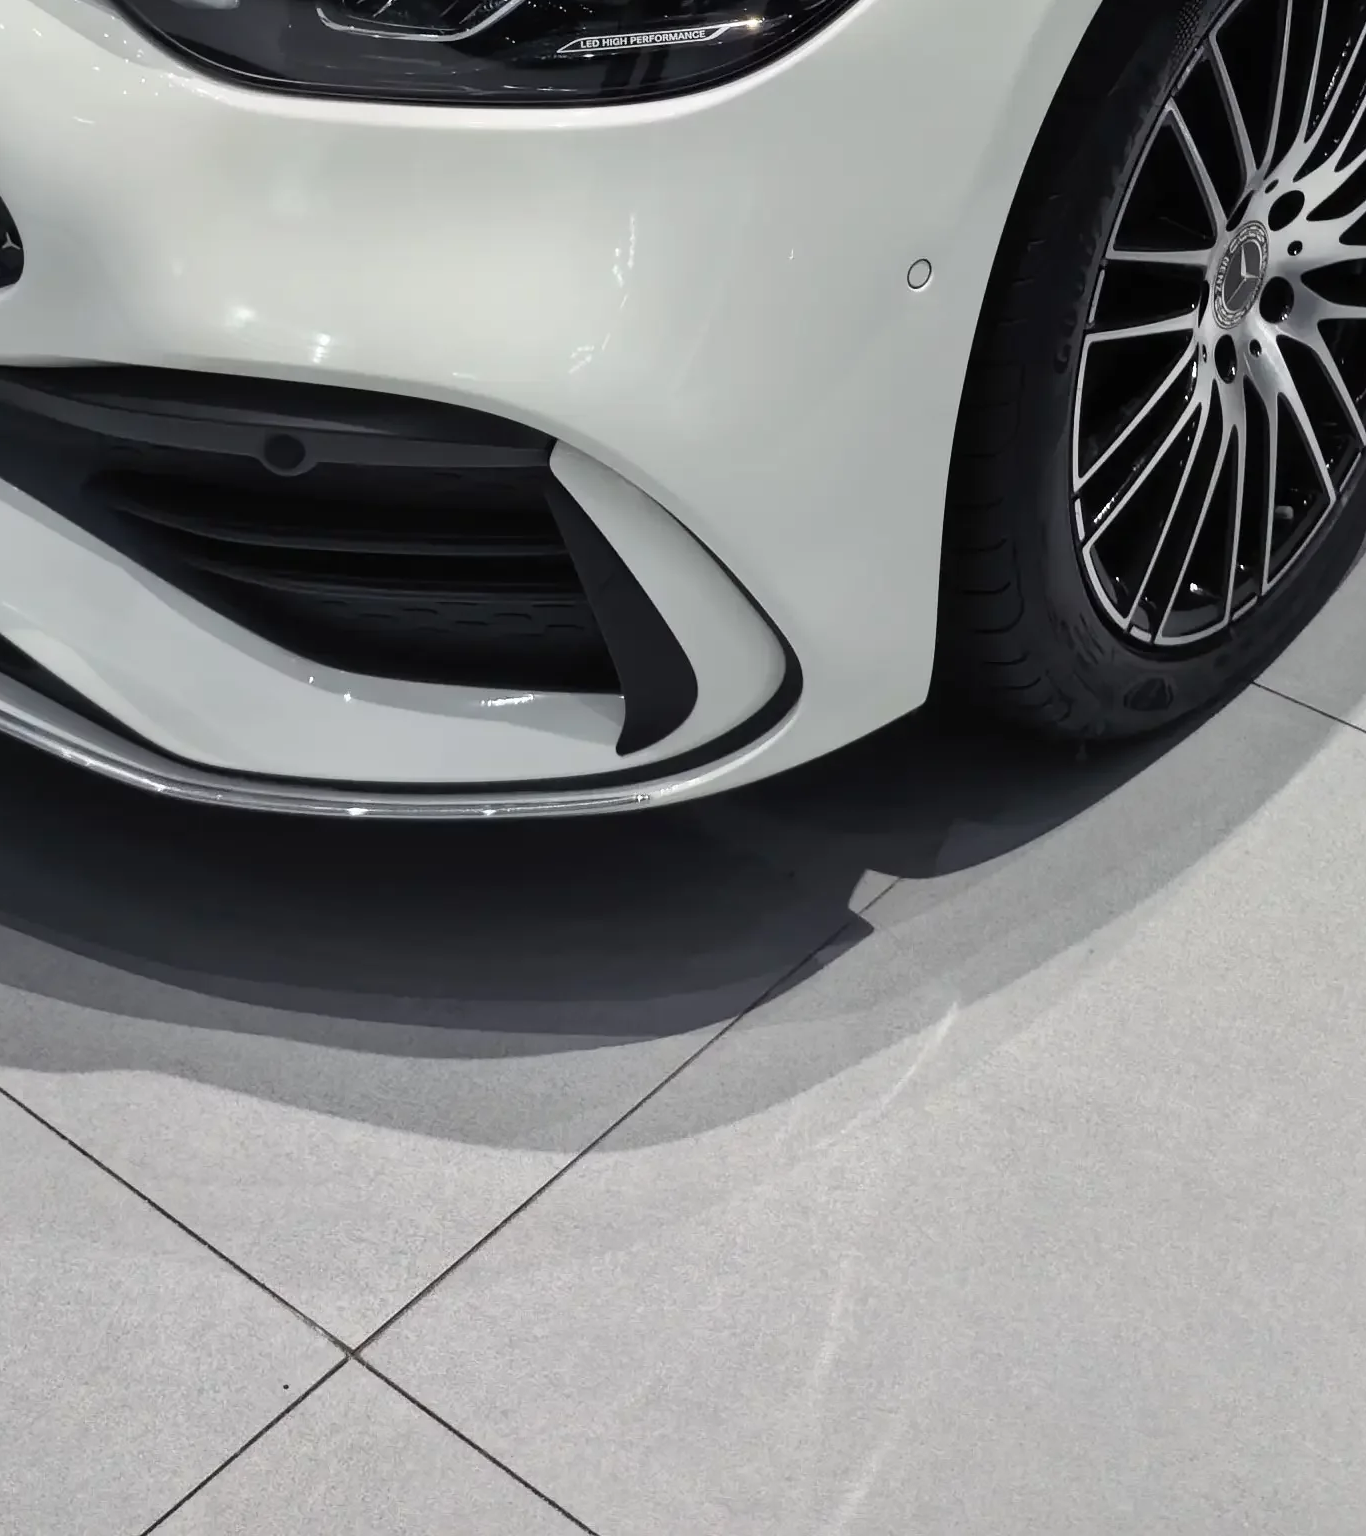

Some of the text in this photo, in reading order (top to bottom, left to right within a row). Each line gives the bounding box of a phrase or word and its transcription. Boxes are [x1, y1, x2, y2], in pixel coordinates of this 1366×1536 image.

[580, 31, 706, 49] LED HIGH PERFORMANCE
